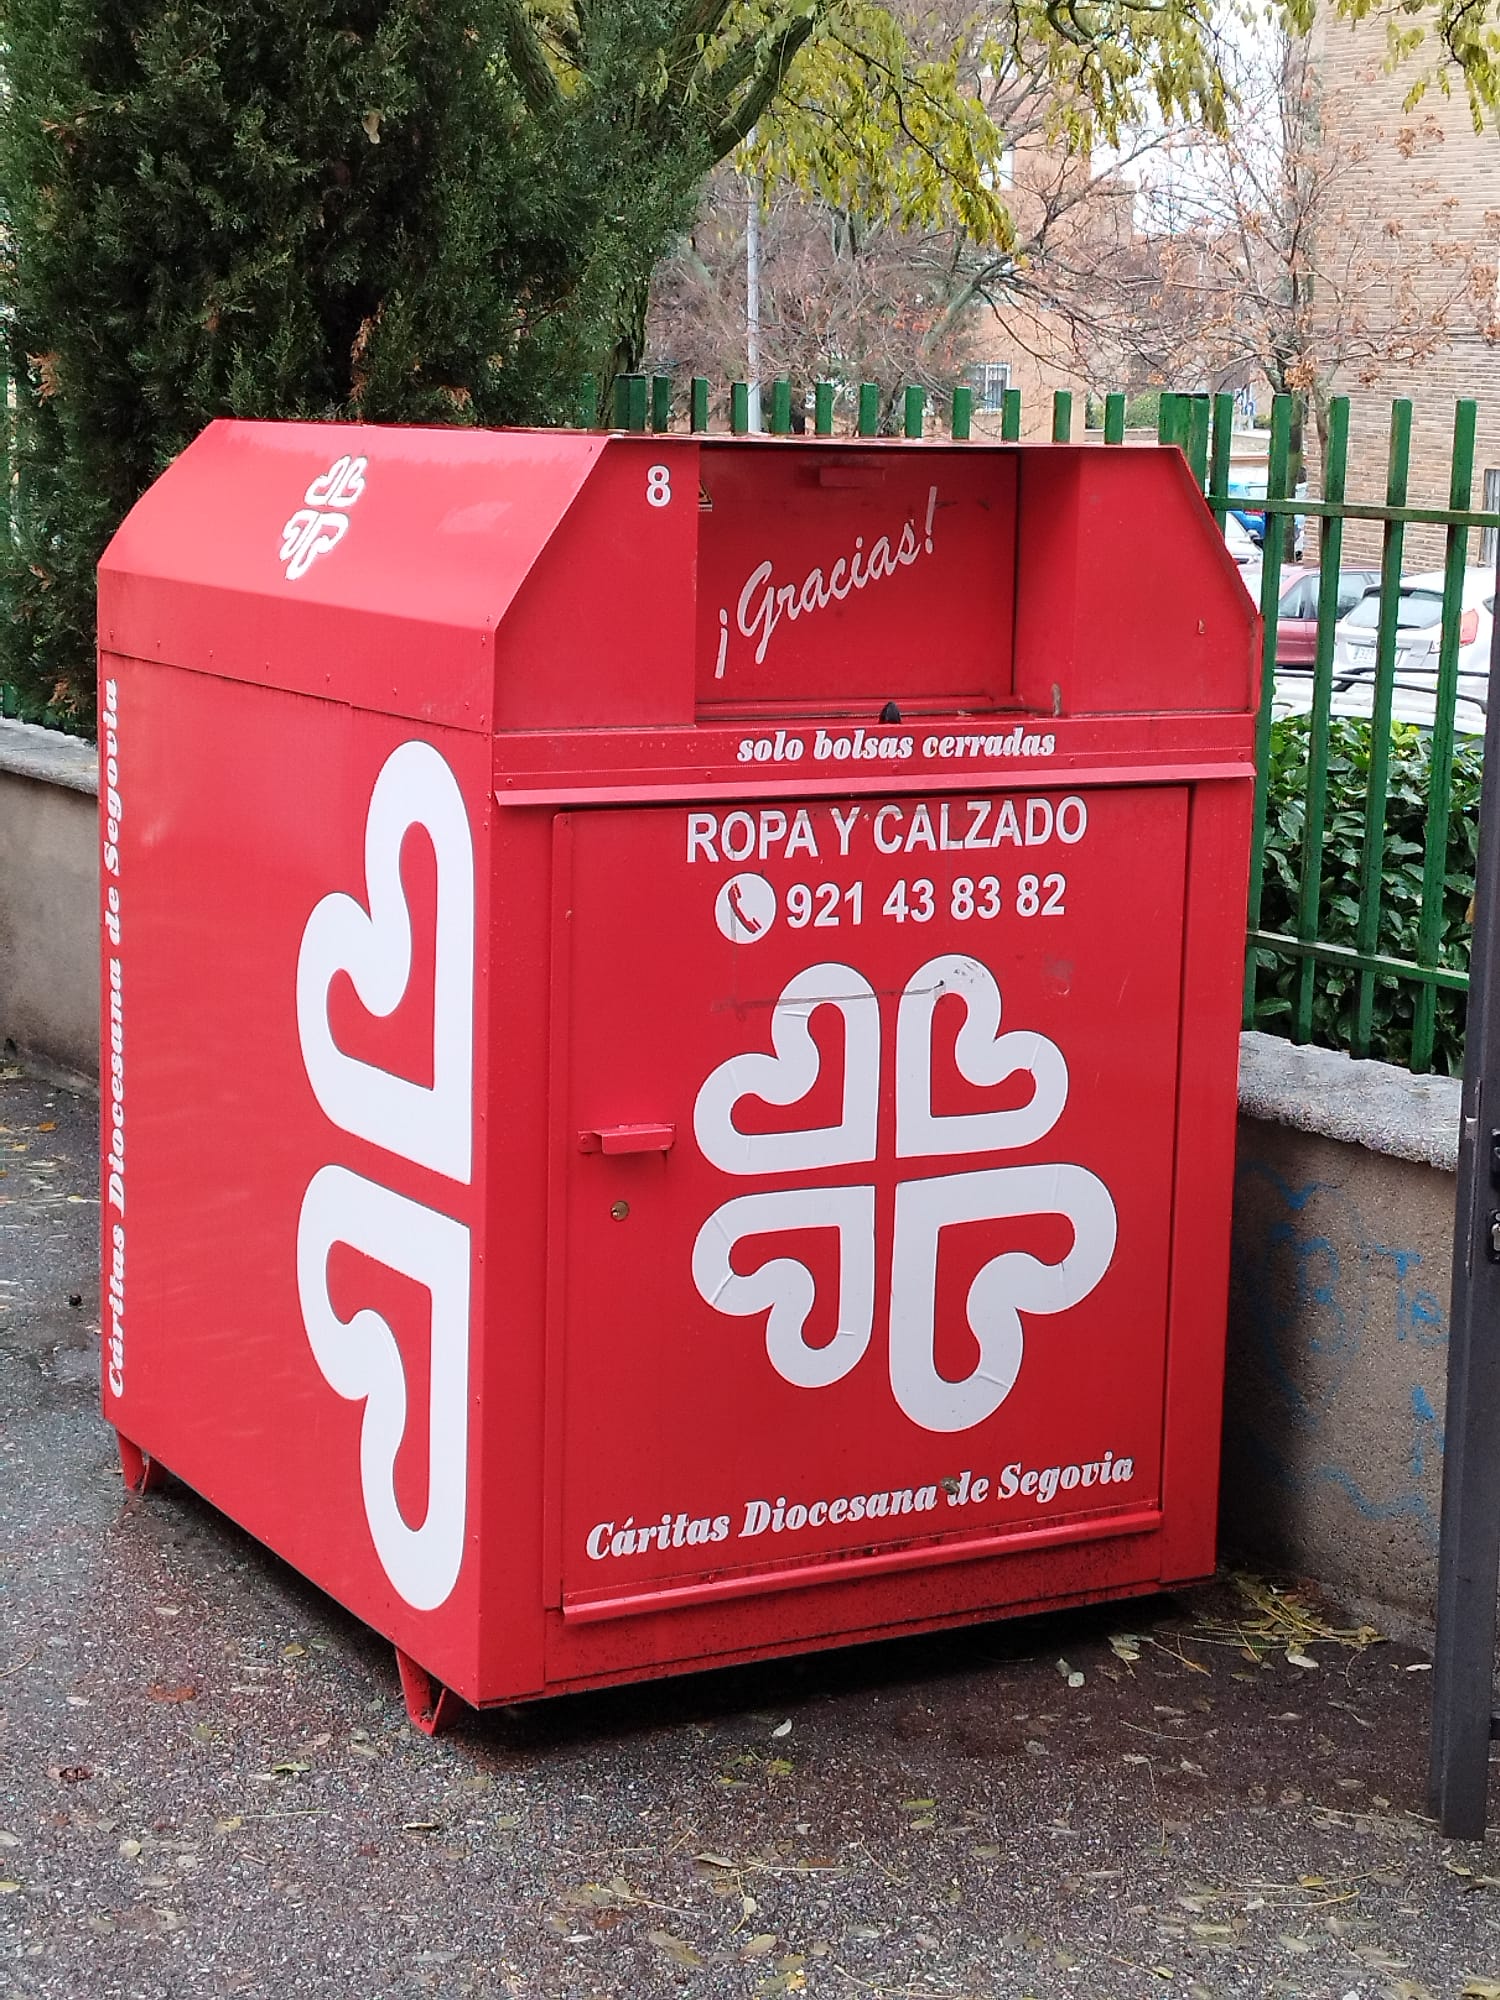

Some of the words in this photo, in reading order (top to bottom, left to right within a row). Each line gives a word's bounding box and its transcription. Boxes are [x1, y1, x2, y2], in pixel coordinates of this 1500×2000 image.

[645, 465, 672, 508] 8
[714, 486, 938, 679] ¡Gracias!
[102, 678, 122, 877] Segovia
[737, 730, 804, 763] solo
[813, 729, 914, 760] bolsas
[922, 725, 1057, 758] cerradas
[686, 810, 820, 864] ROPA
[829, 806, 862, 857] Y
[873, 795, 1089, 855] CALZADO
[105, 886, 121, 946] de
[786, 881, 864, 929] 921
[882, 878, 936, 924] 43
[950, 876, 1002, 921] 83
[1016, 873, 1067, 918] 82
[108, 957, 125, 1219] Diocesana
[108, 1224, 125, 1398] Cáritas
[586, 1513, 731, 1560] Cáritas
[738, 1485, 937, 1538] Diocesana
[947, 1471, 989, 1506] de
[997, 1451, 1135, 1504] Segovia
